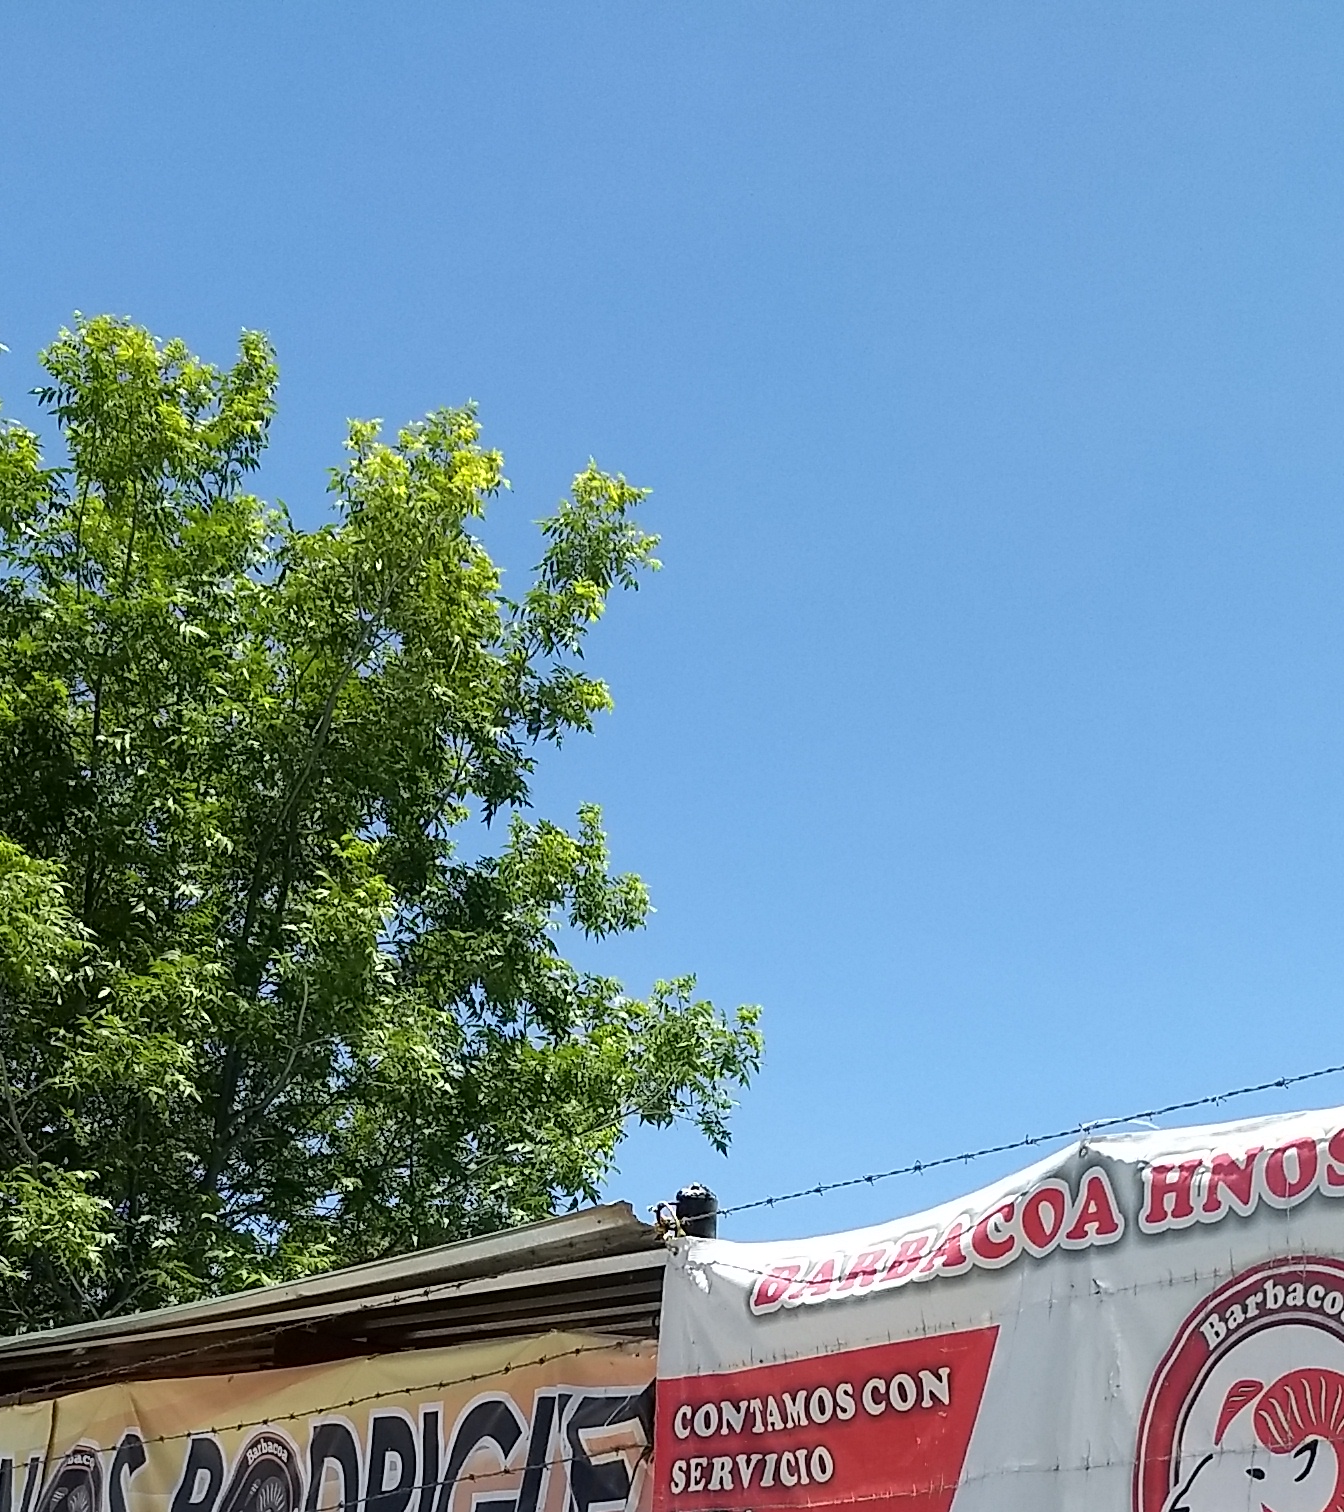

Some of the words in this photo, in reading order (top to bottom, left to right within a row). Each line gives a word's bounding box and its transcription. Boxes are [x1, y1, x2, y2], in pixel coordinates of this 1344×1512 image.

[751, 1174, 1121, 1309] BARBACOA
[673, 1382, 856, 1440] CONTAMOS
[862, 1366, 951, 1416] CON
[246, 1438, 289, 1466] Barbacoa
[670, 1445, 835, 1495] SERVICIO
